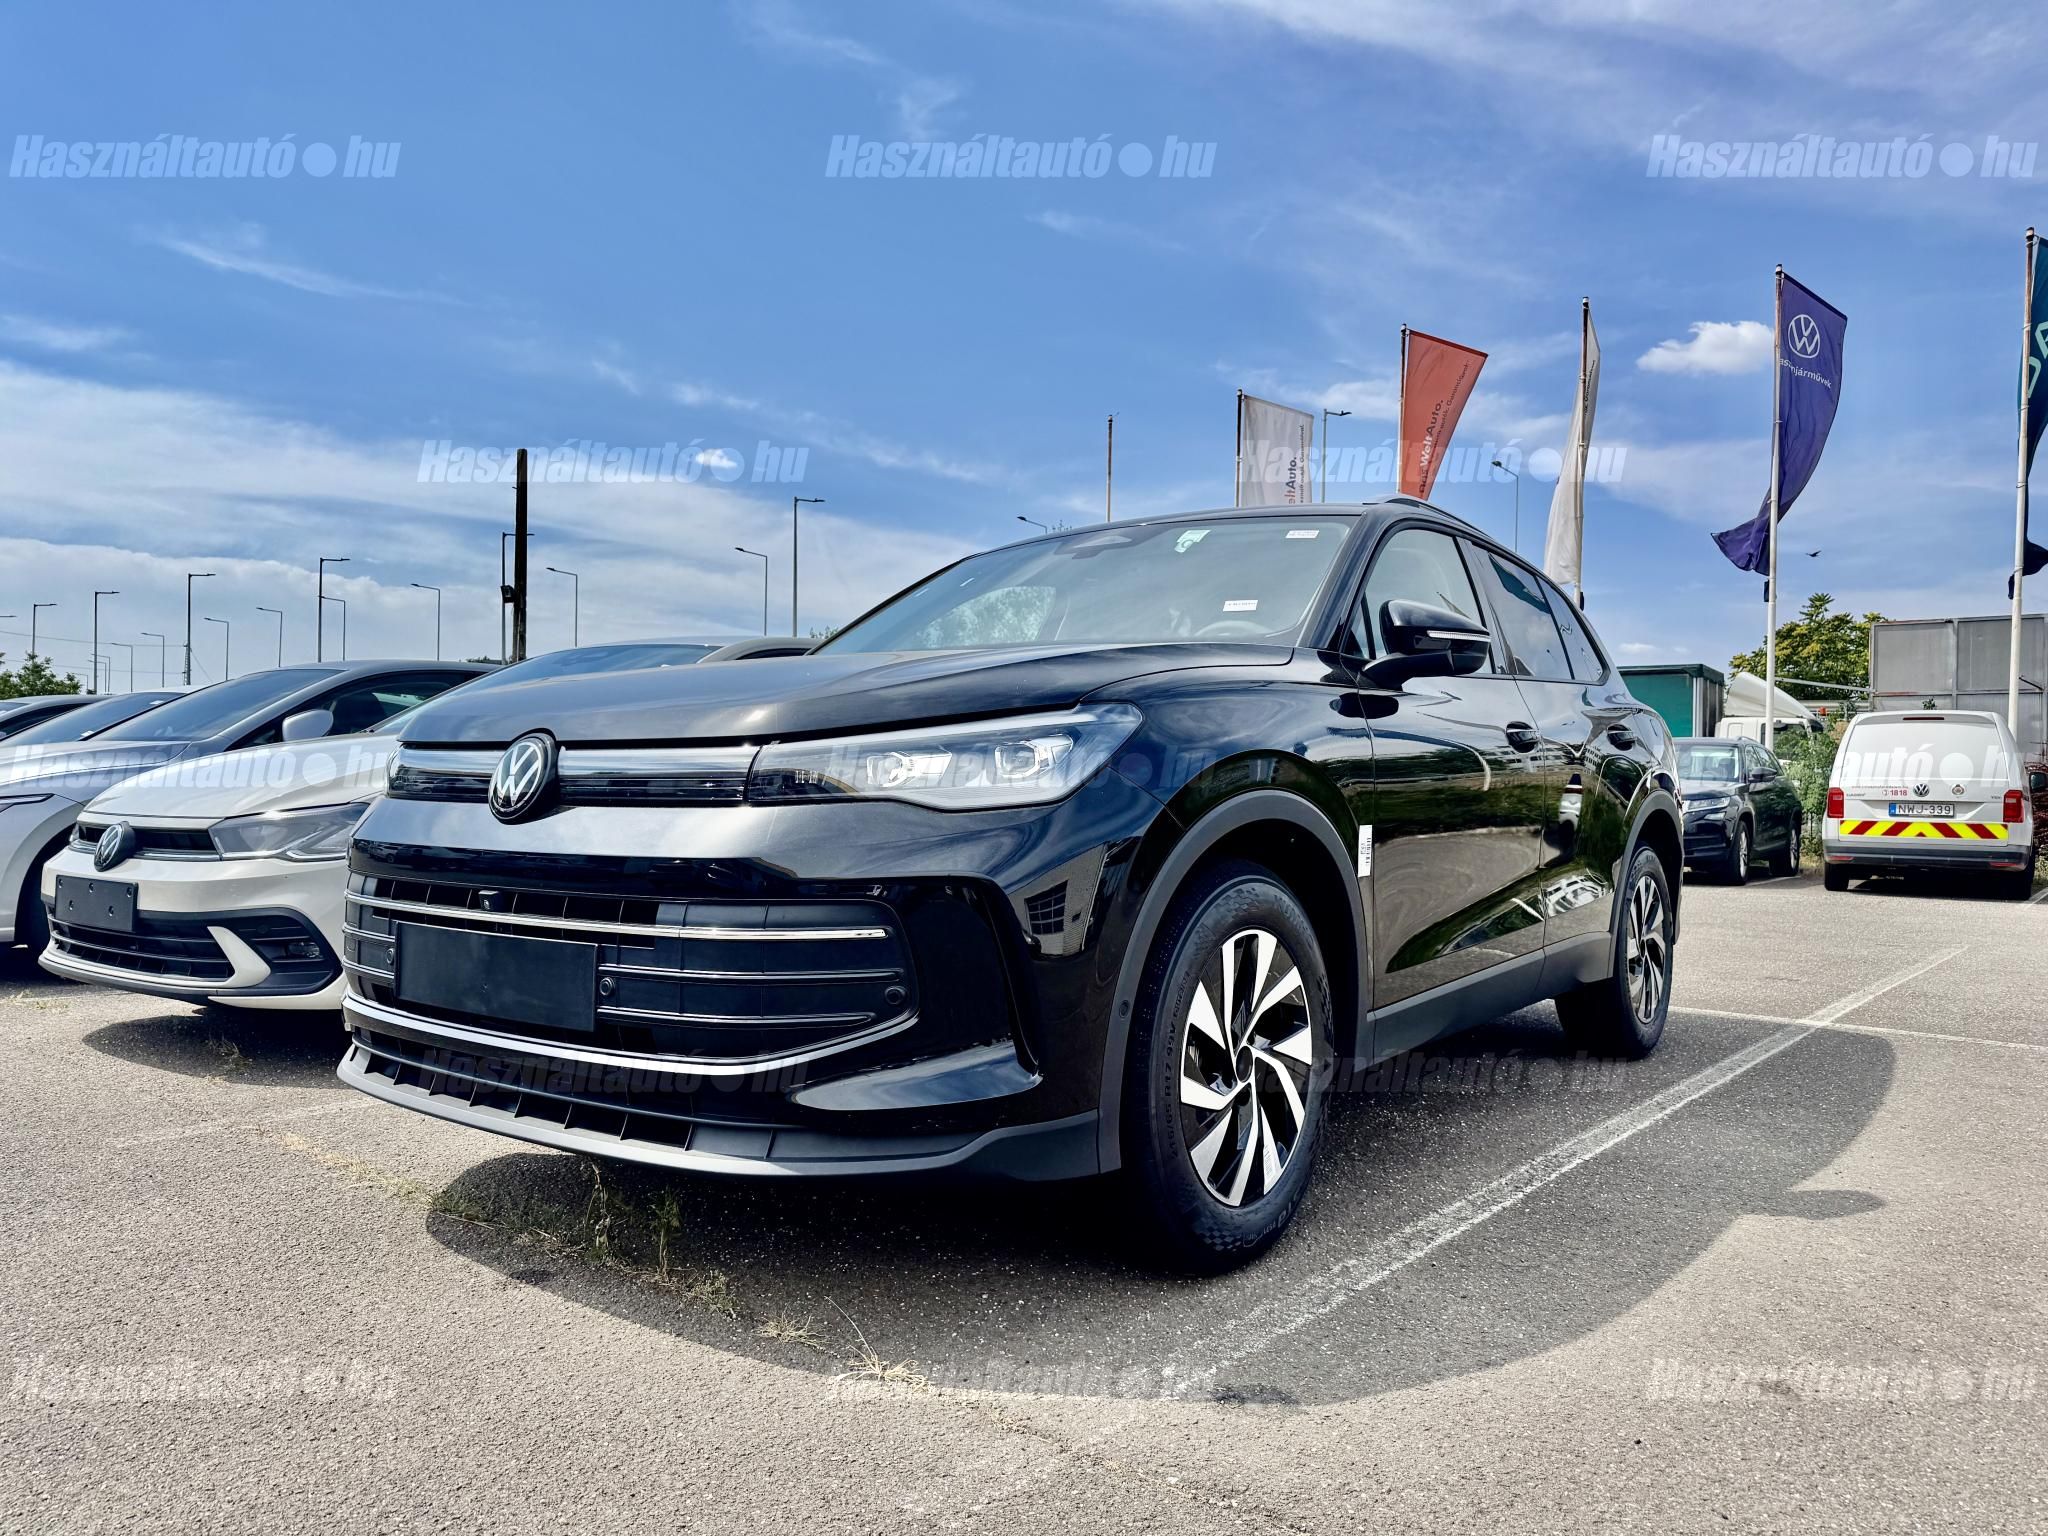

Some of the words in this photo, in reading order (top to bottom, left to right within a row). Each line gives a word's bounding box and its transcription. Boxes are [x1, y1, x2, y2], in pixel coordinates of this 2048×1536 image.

[1284, 456, 1297, 504] eltAuto.
[1890, 789, 1908, 797] 1818
[1898, 803, 1952, 815] NWJ-339
